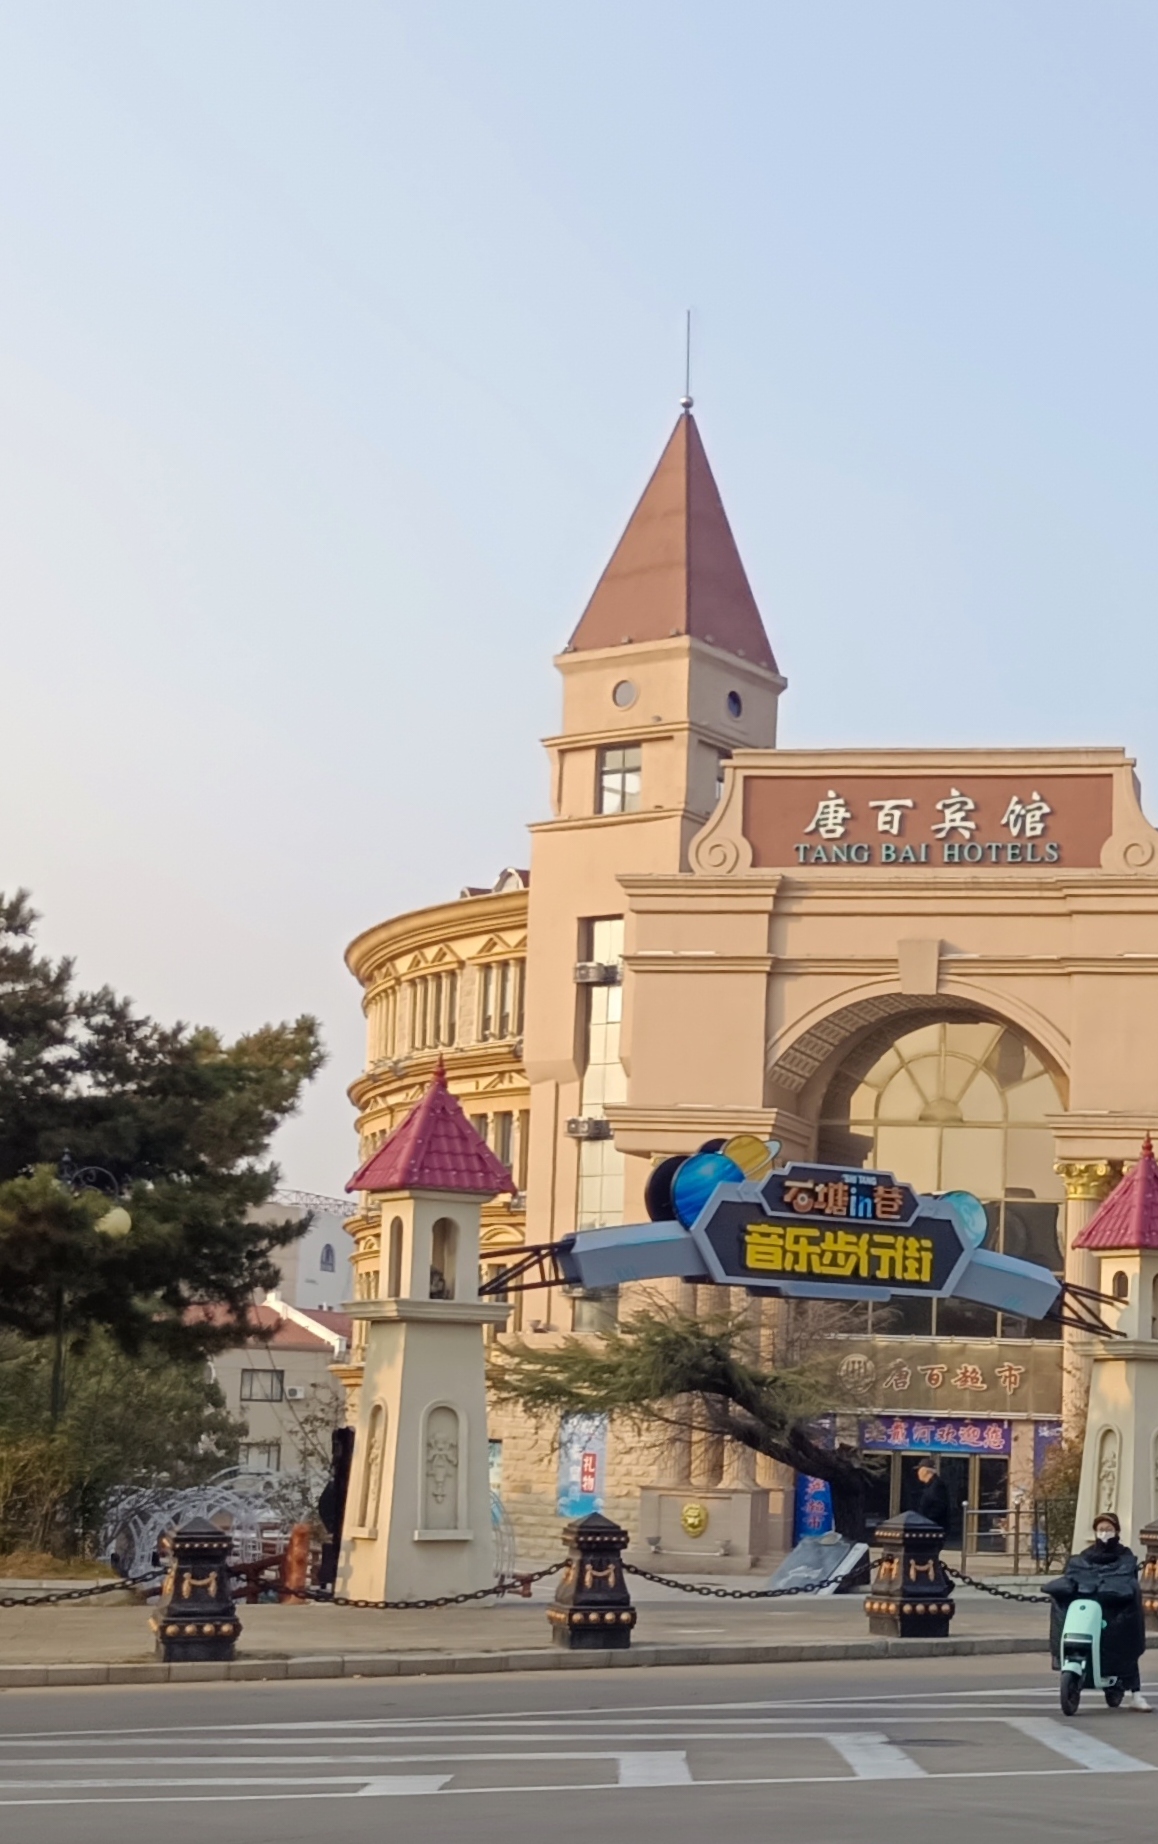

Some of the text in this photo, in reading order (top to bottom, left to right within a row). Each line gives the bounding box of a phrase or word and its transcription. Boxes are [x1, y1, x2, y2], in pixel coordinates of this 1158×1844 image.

[803, 788, 1052, 840] 唐百宾馆
[794, 842, 1060, 864] TANG BAI HOTELS
[744, 1223, 933, 1283] 音乐步行街
[883, 1358, 1024, 1395] 唐百超市
[864, 1420, 1006, 1450] 北戴河欢迎您
[582, 1455, 596, 1492] 礼物
